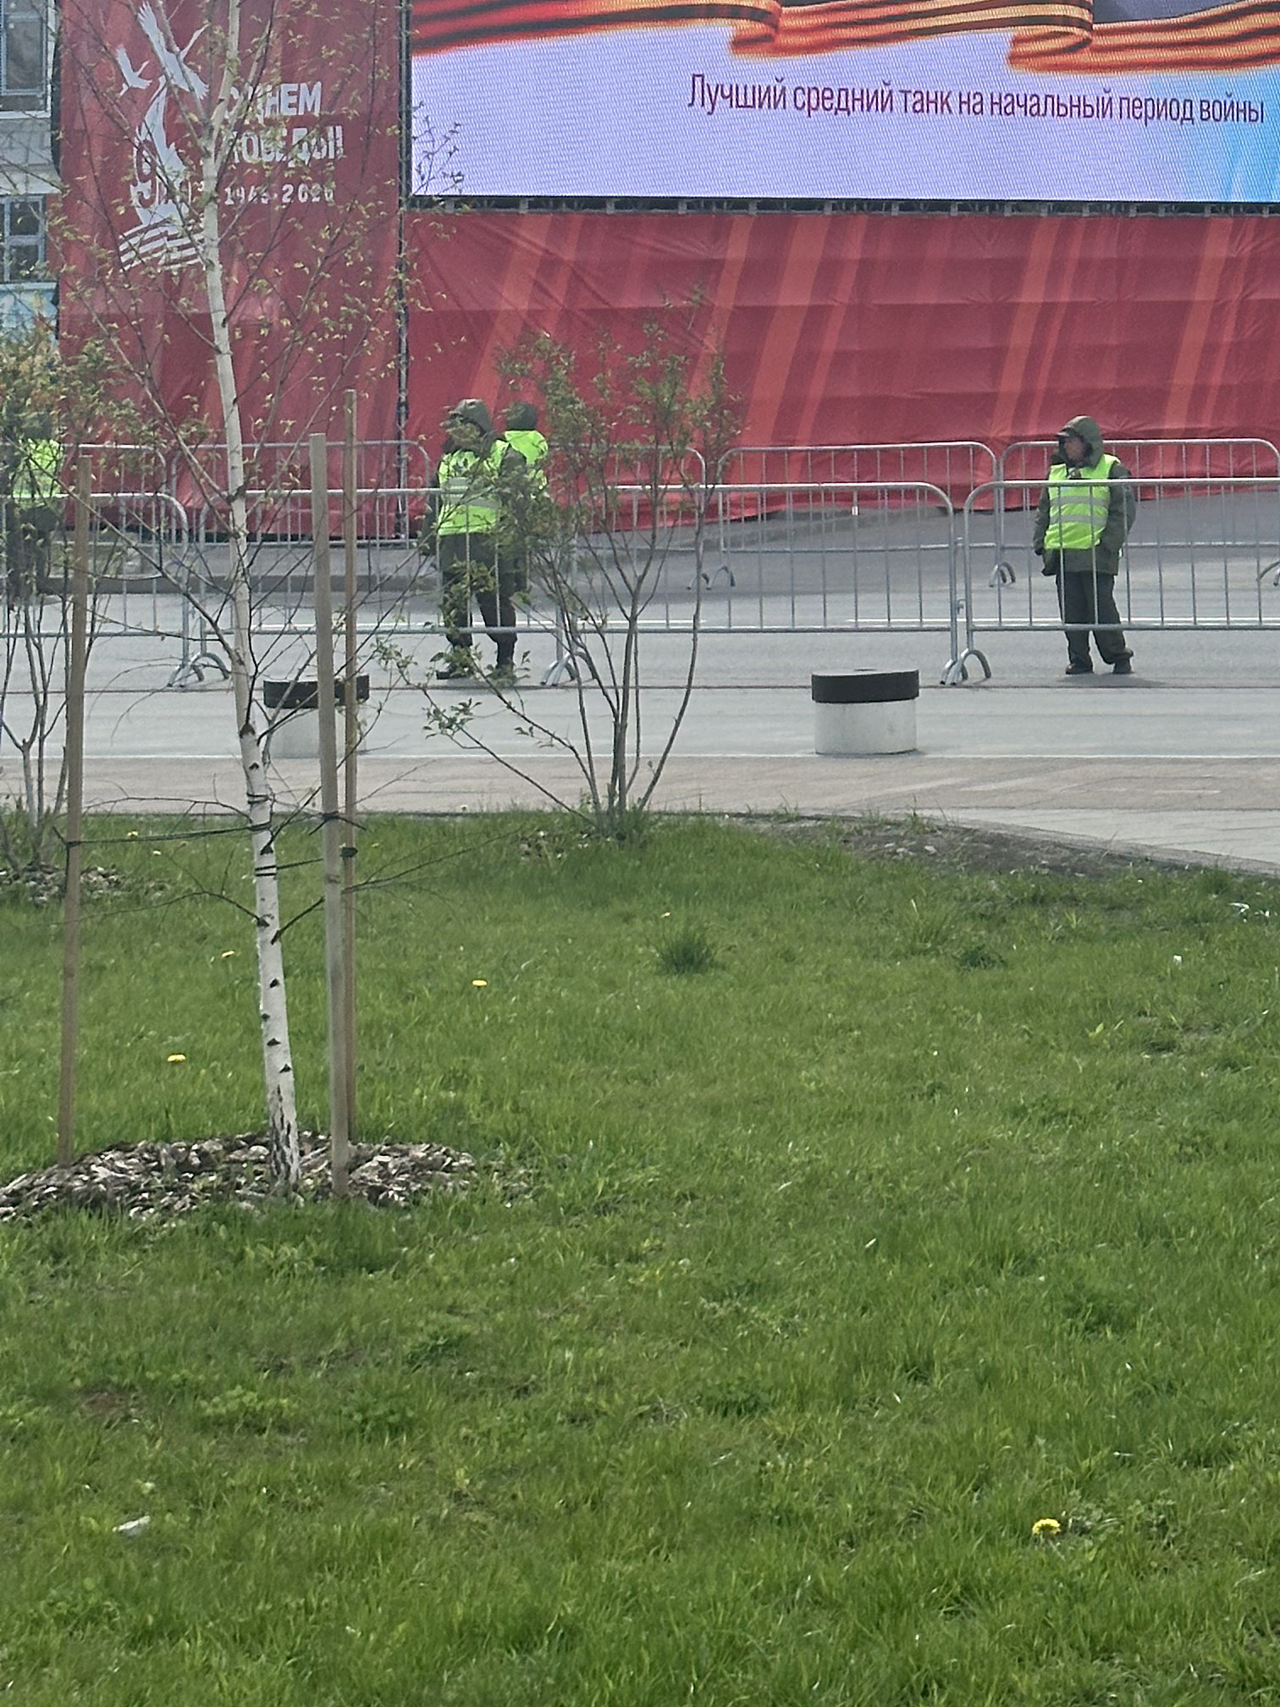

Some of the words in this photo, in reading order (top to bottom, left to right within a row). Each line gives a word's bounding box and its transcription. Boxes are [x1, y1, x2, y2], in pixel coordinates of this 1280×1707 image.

[688, 73, 787, 115] Лучший
[793, 79, 894, 118] средний
[899, 89, 953, 115] танк
[958, 91, 984, 116] на
[990, 88, 1113, 120] начальный
[1118, 97, 1195, 127] период
[1199, 92, 1265, 123] войны
